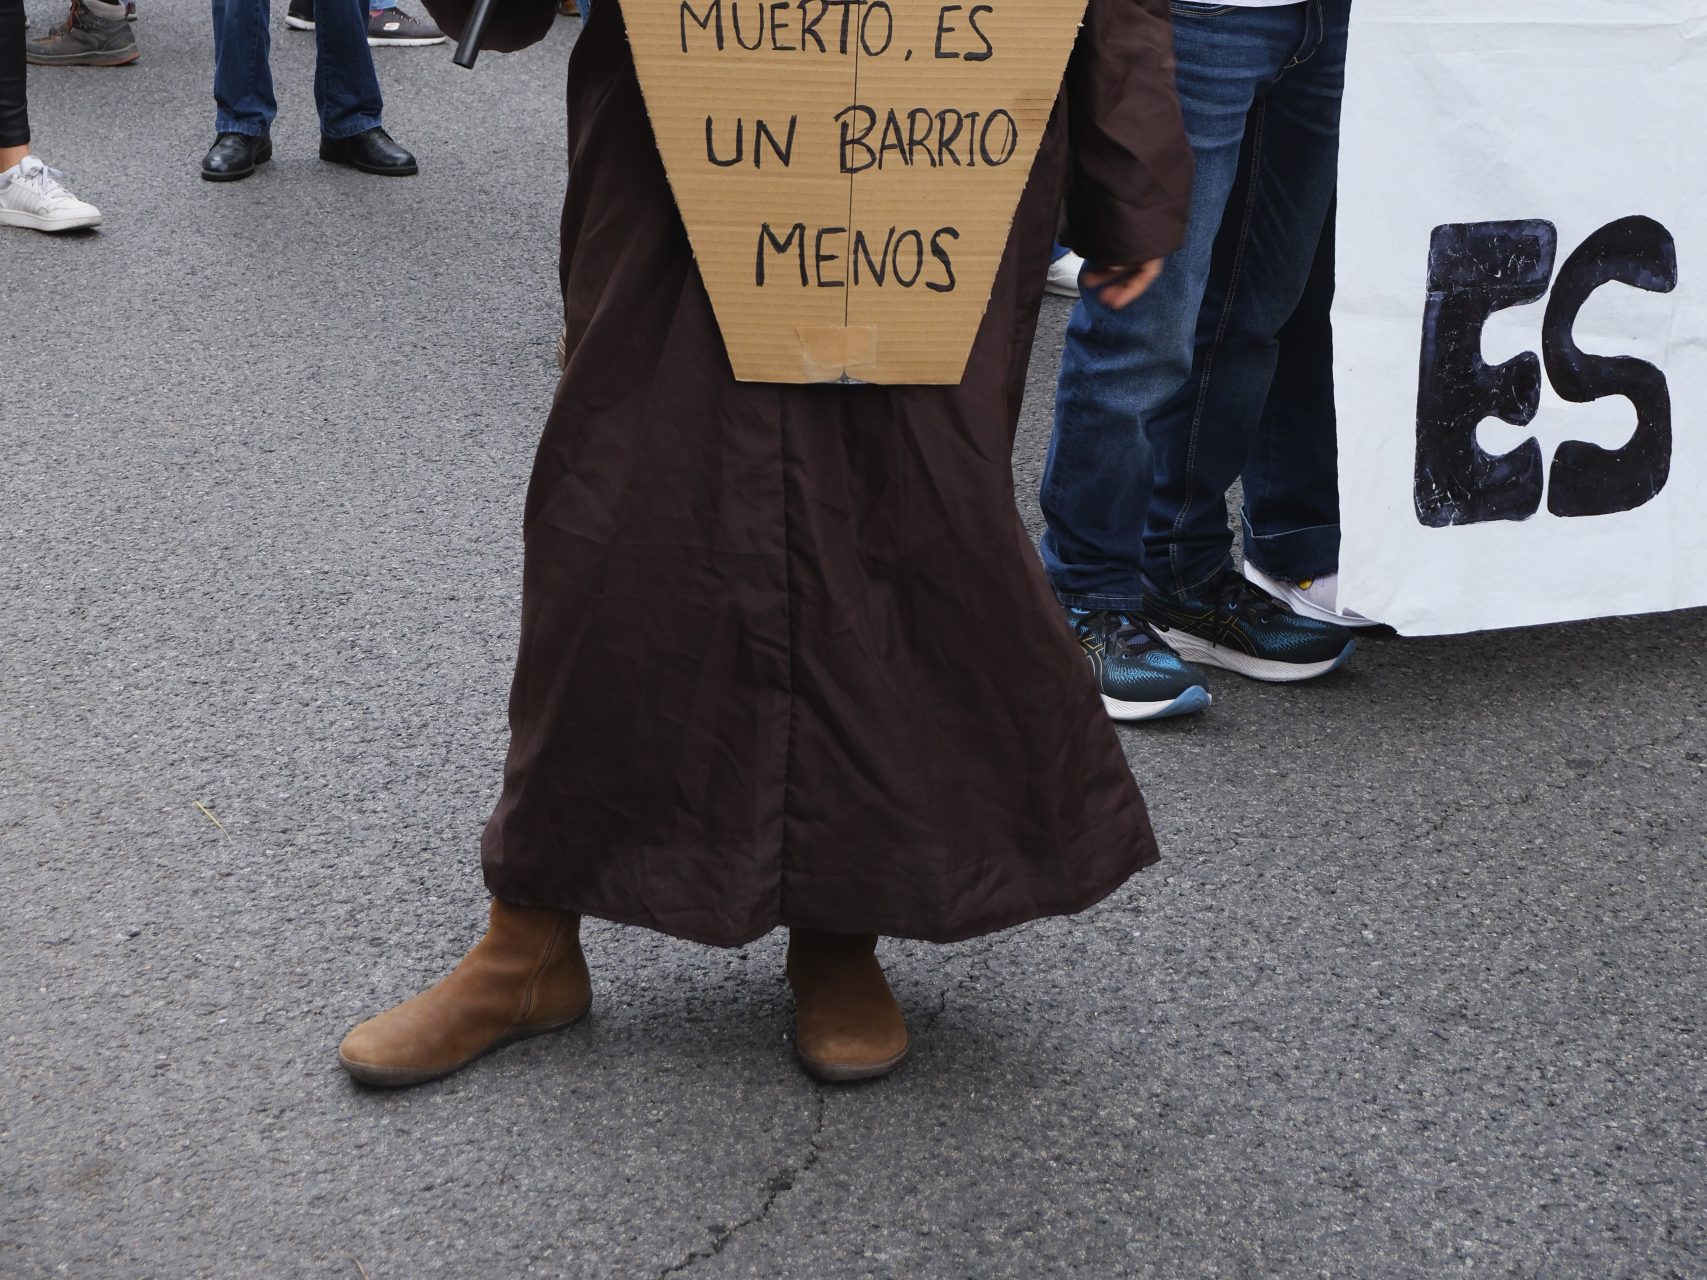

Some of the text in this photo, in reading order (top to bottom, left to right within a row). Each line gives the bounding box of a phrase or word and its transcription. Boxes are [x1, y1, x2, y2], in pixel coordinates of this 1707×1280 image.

[934, 4, 994, 62] ES
[705, 105, 1018, 174] UN BARRIO
[755, 222, 960, 293] MENOS
[1413, 214, 1678, 528] ES
